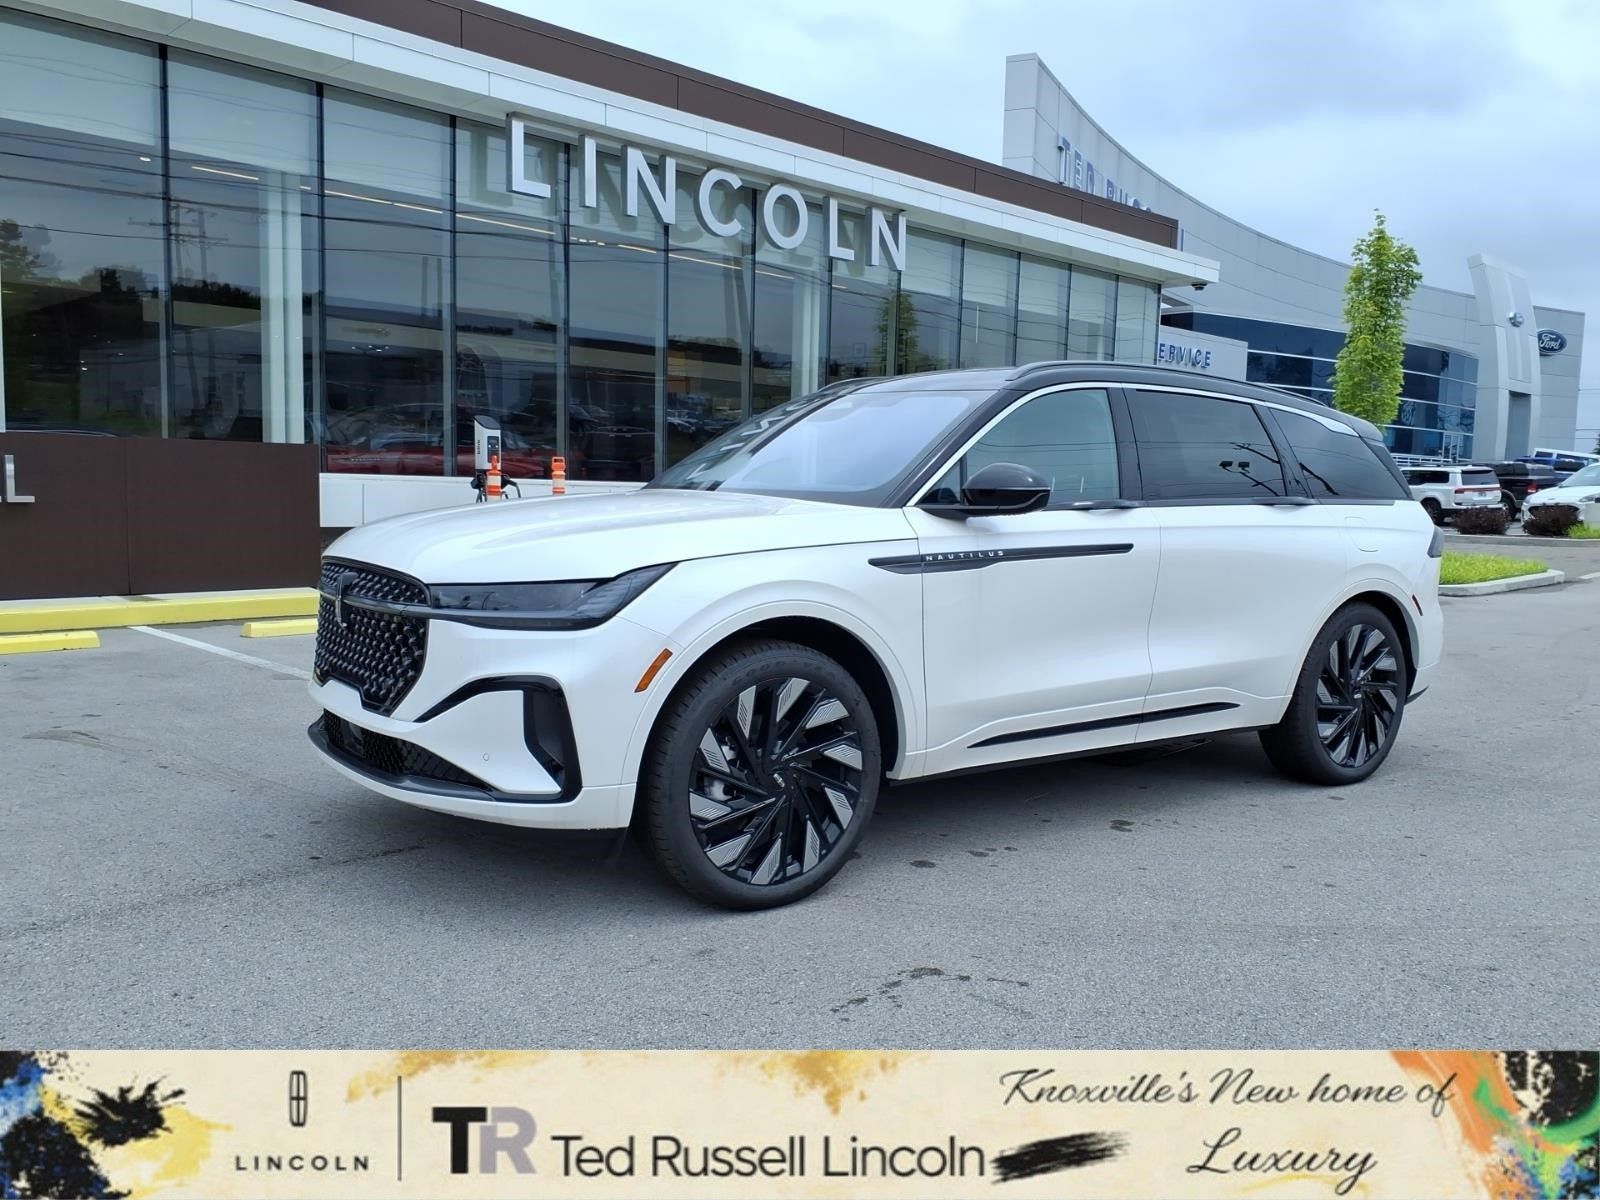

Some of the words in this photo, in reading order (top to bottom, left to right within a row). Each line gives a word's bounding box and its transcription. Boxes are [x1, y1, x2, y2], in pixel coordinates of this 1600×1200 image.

[506, 112, 906, 271] LINCOLN
[0, 454, 35, 503] L
[926, 550, 1004, 561] NAUTILUS
